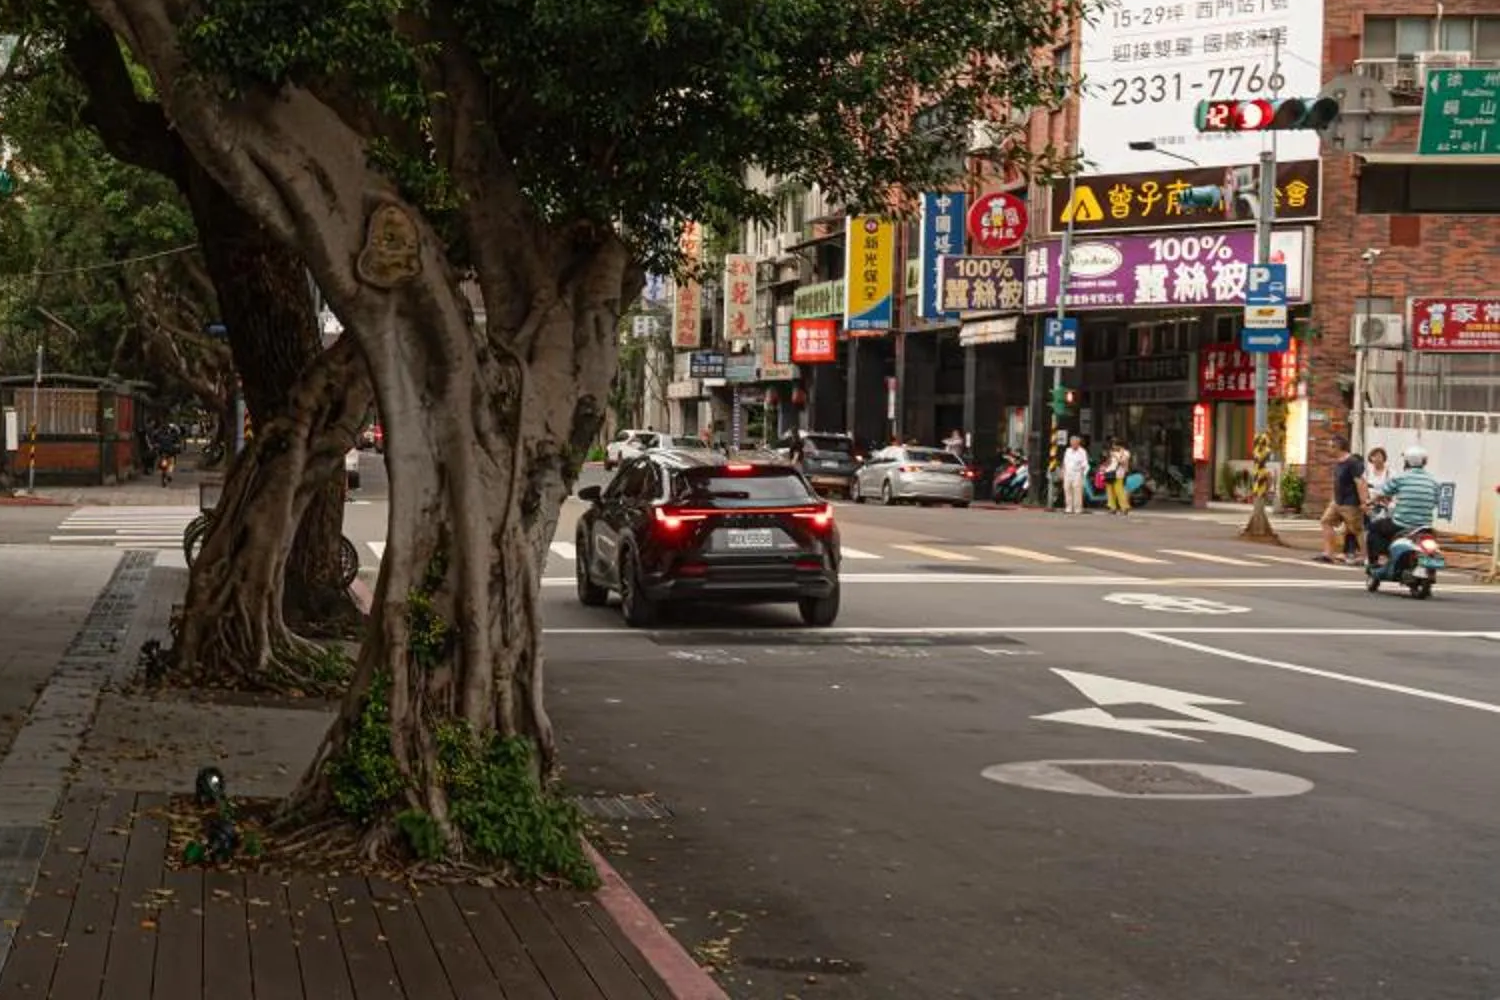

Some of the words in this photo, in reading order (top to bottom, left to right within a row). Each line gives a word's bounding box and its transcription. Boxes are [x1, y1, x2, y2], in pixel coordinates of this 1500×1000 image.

[1110, 62, 1286, 107] 2331-7766
[1108, 177, 1310, 220] 曾子南會
[1148, 234, 1233, 262] 100%
[954, 259, 1014, 278] 100%
[1249, 267, 1271, 292] P
